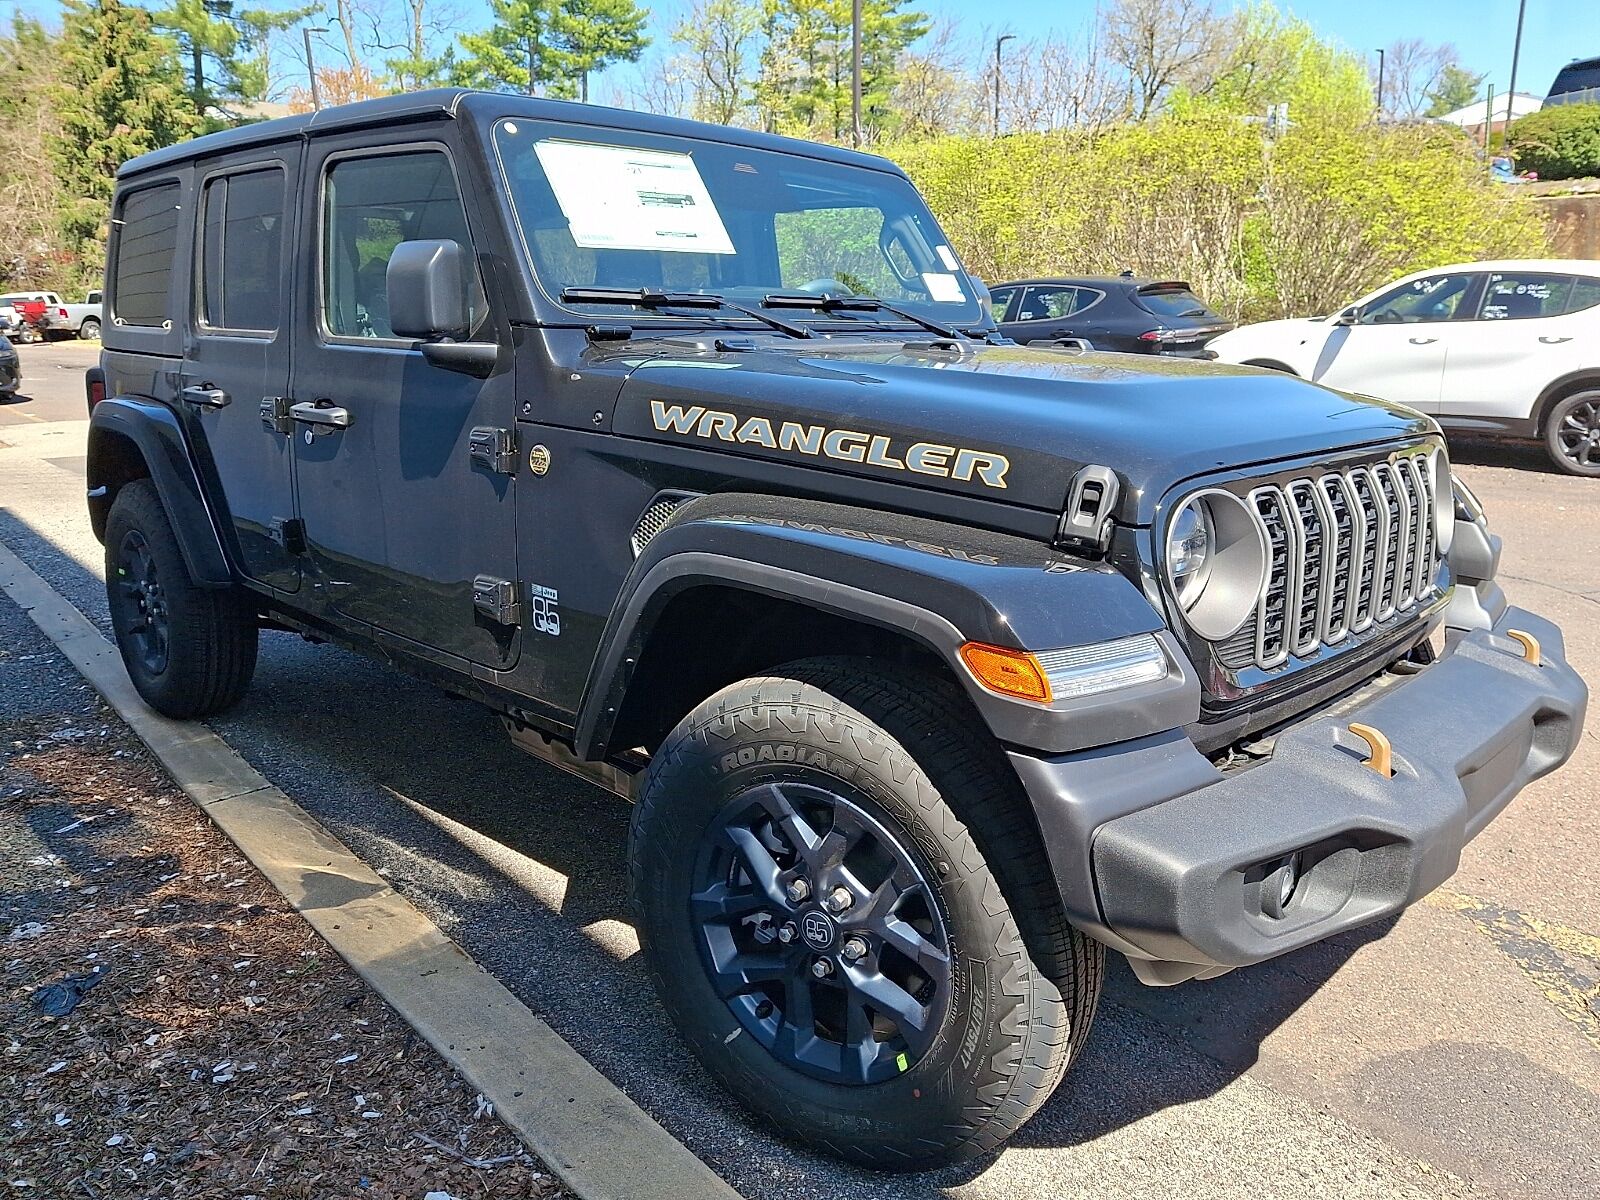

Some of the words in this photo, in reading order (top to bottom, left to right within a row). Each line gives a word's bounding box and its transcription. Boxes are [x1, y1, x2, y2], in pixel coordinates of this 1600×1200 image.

[650, 399, 1010, 490] WRANGLER
[720, 744, 854, 778] ROADIAN
[961, 983, 984, 1070] 245/75R17
